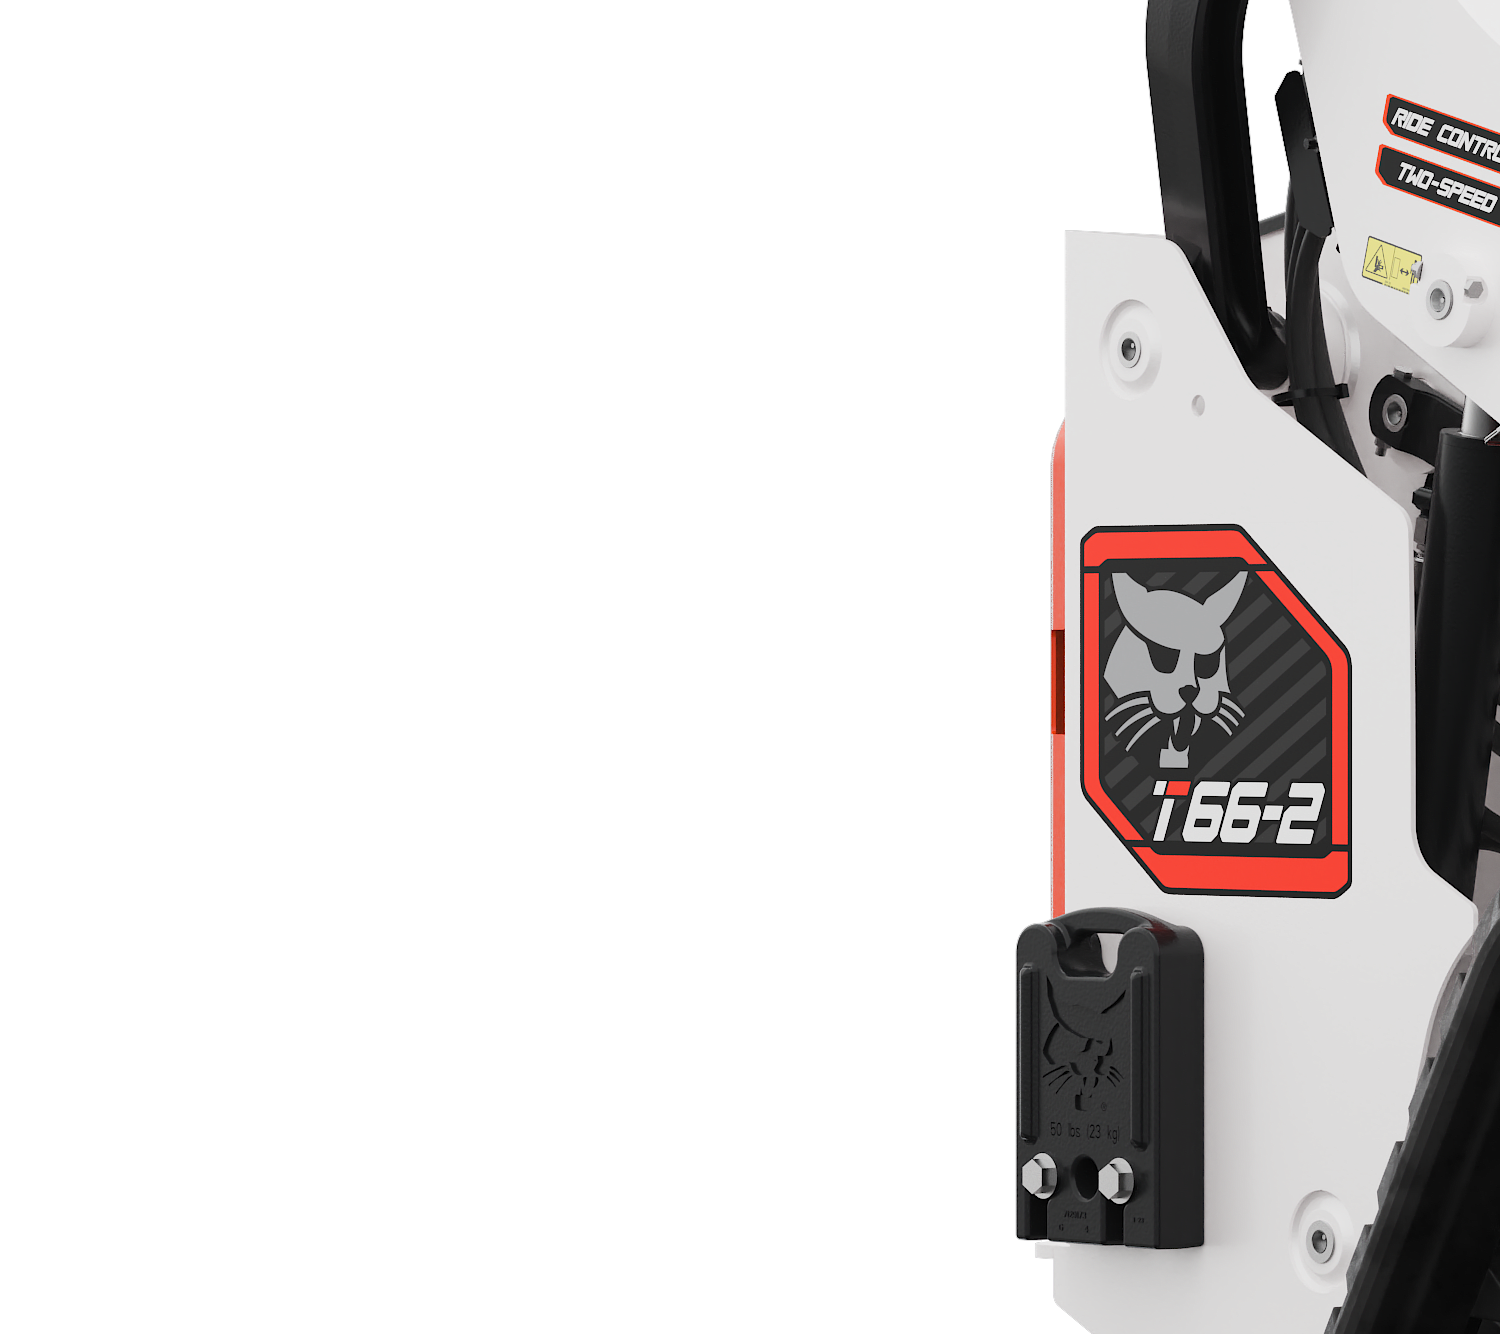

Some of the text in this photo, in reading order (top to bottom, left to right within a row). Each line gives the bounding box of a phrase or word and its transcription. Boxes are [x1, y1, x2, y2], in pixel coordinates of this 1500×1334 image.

[1391, 107, 1435, 137] RIDE
[1397, 161, 1499, 214] TWO-SPEED
[1152, 780, 1326, 845] T66-2
[1050, 1121, 1120, 1145] 50 lbs (23 kg)
